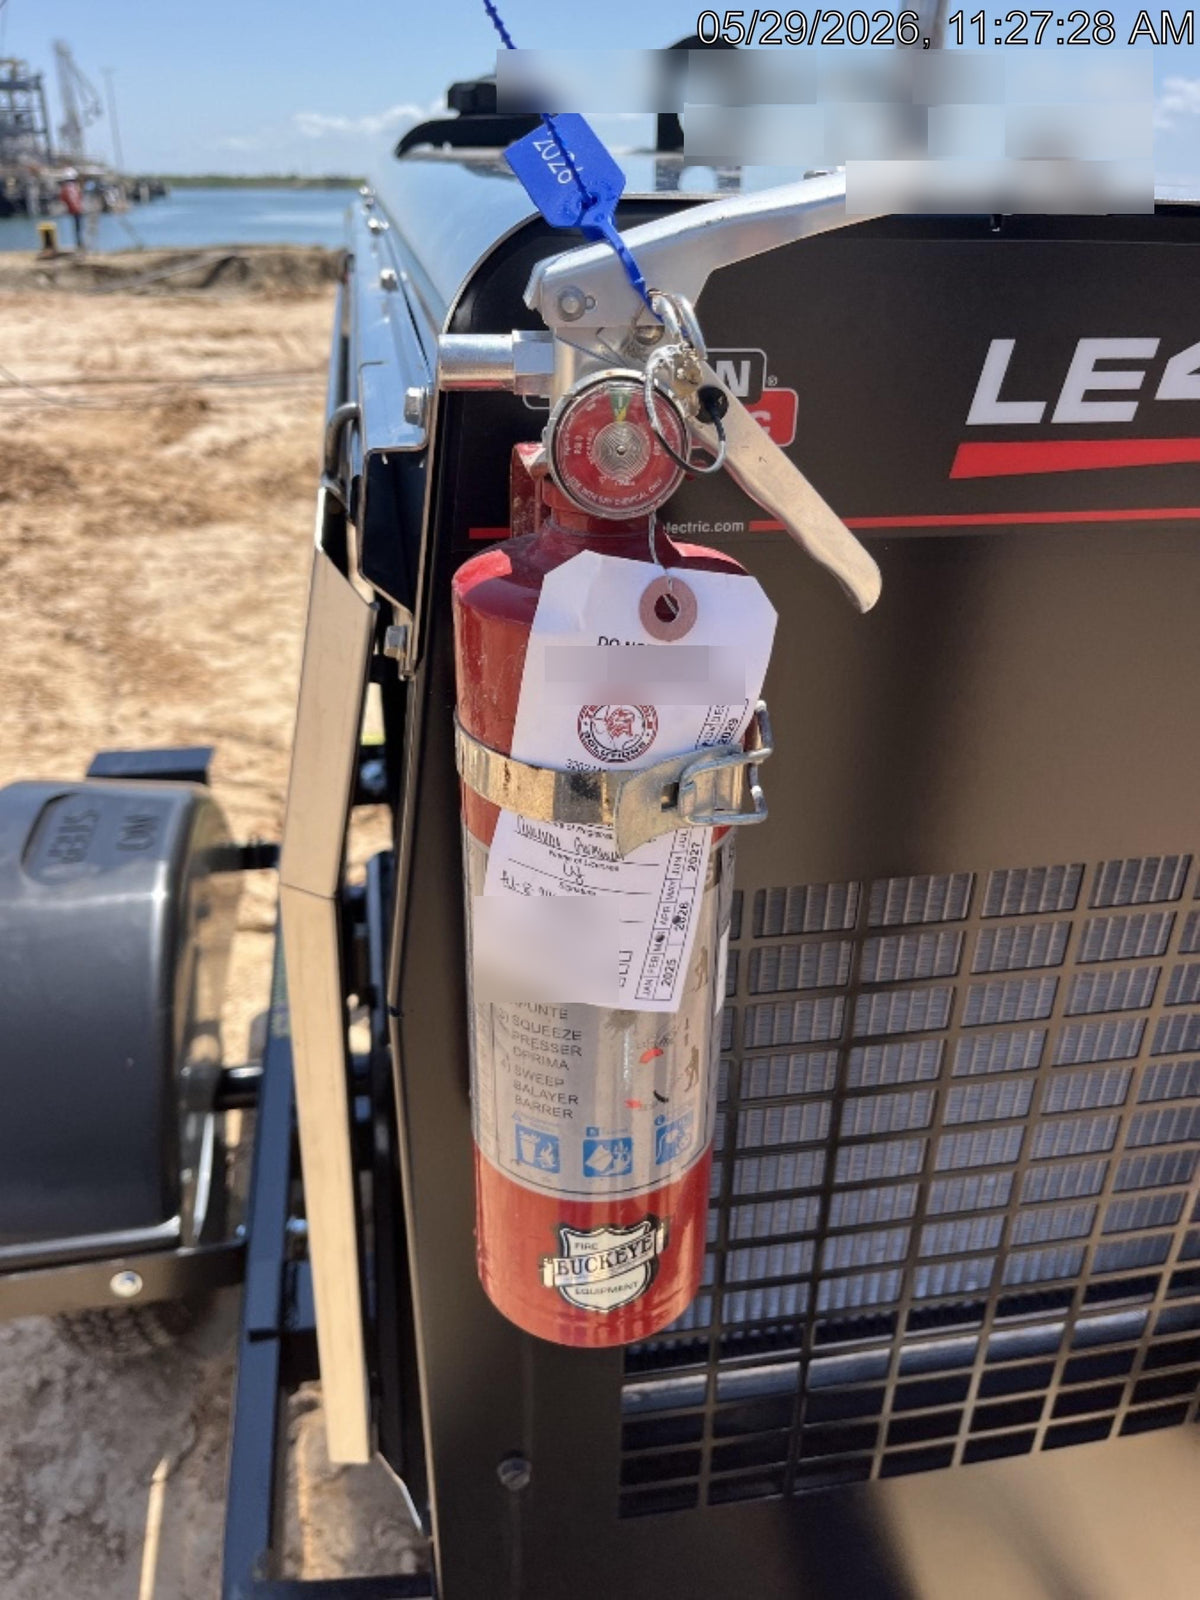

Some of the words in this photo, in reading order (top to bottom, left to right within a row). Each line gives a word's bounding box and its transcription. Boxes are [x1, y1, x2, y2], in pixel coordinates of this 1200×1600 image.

[664, 520, 744, 534] lectric.com
[660, 959, 677, 987] 2025
[687, 842, 701, 872] 2027
[511, 1013, 583, 1041] SQUEEZE
[511, 1029, 583, 1057] PRESSER
[514, 1063, 565, 1087] SWEEP
[513, 1078, 579, 1105] BALAYER
[515, 1094, 574, 1119] BARRER
[556, 1236, 654, 1276] BUCKEYE
[574, 1241, 598, 1250] FIRE
[575, 1281, 638, 1296] EQUIPMENT
